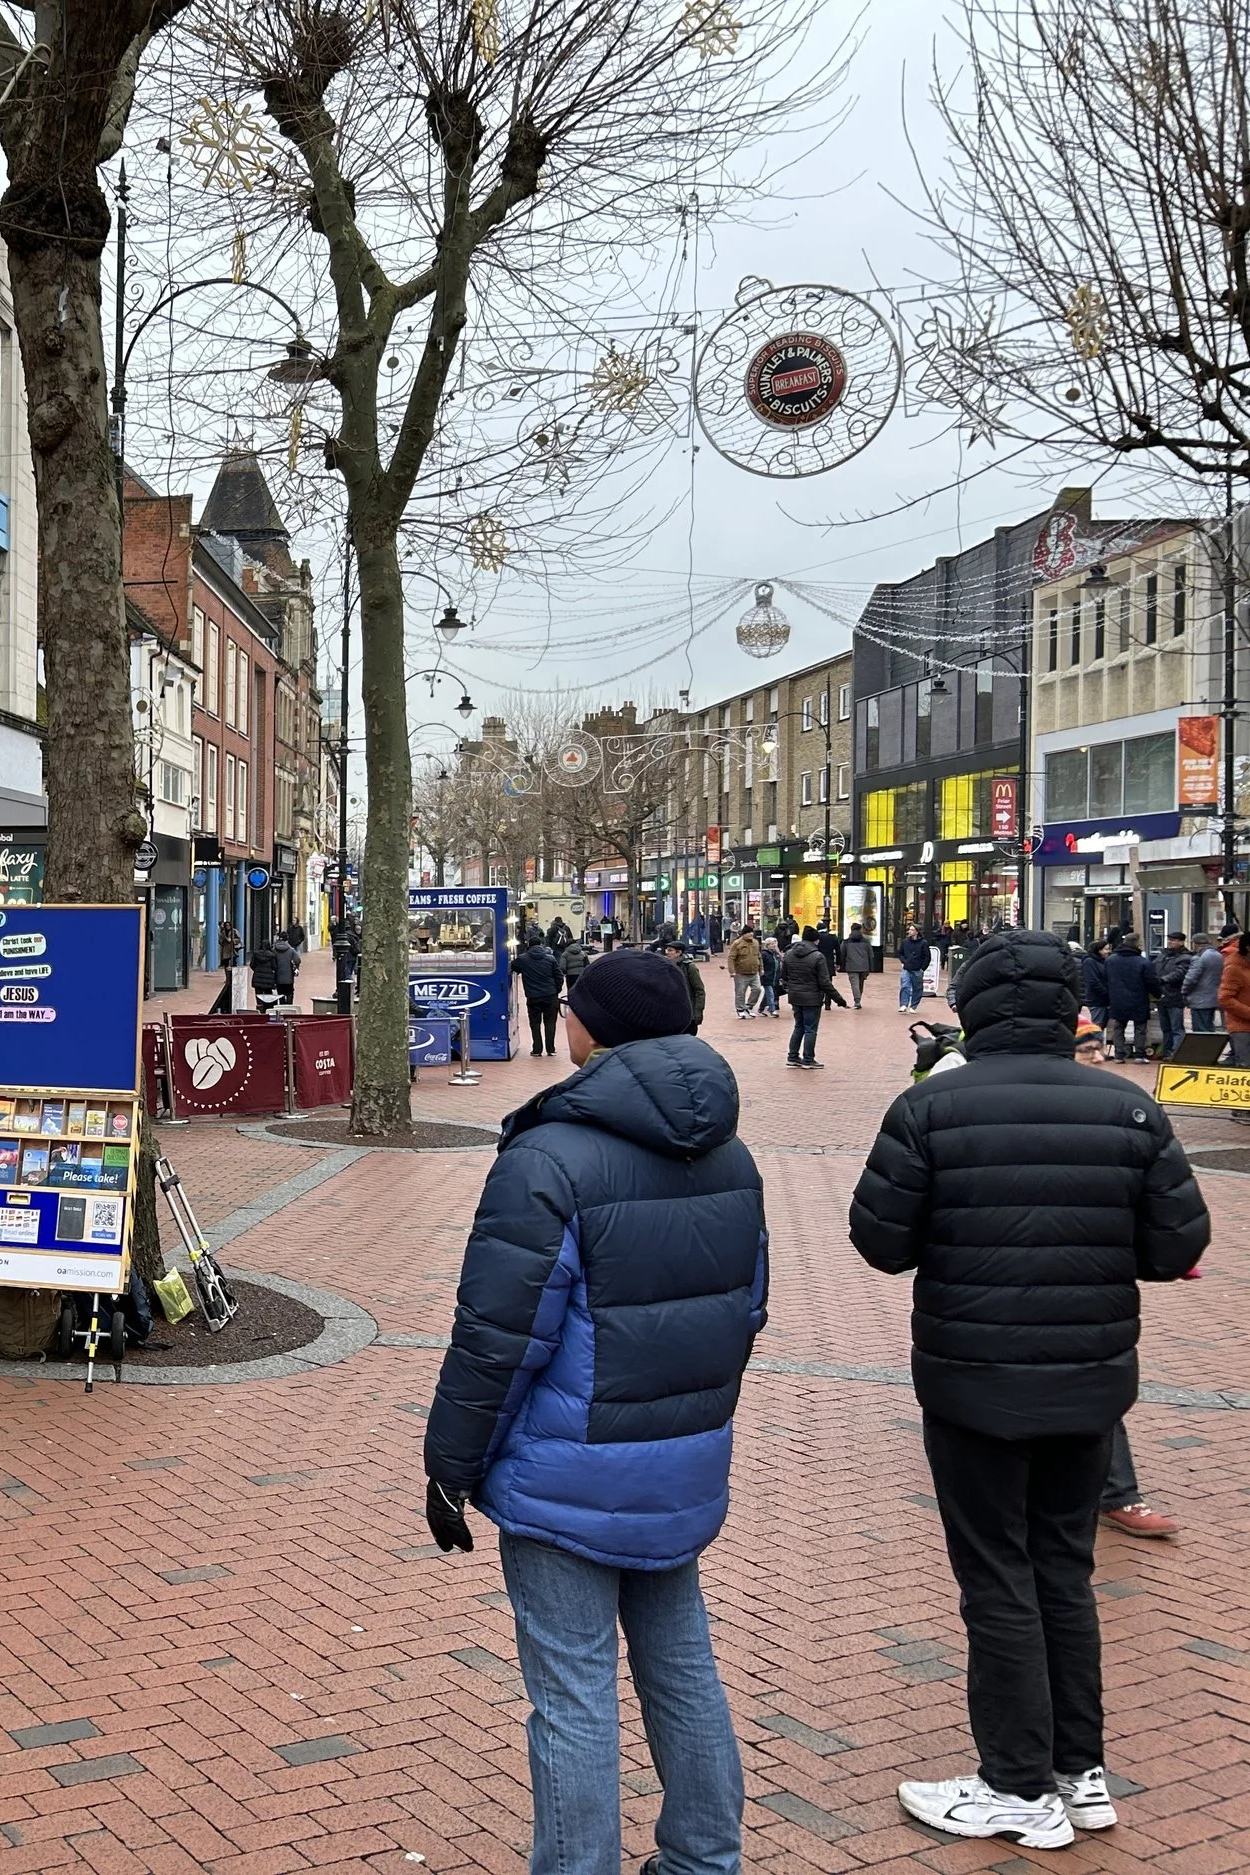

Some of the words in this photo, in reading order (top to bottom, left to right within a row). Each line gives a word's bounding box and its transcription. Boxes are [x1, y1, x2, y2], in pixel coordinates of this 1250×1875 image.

[749, 351, 770, 396] SUPERIOR
[769, 336, 812, 352] READING
[814, 340, 844, 375] BISCUITS
[760, 350, 786, 399] HUNTLEY
[797, 346, 833, 383] PALMERS
[774, 371, 817, 392] BREAKFAST
[770, 388, 827, 415] BISCUITS
[438, 893, 464, 905] FRESH
[465, 893, 497, 905] COFFEE
[2, 987, 35, 1002] JESUS
[414, 984, 469, 1000] MEZZO
[4, 1011, 15, 1019] am
[16, 1009, 27, 1019] the
[315, 1058, 335, 1070] COSTA
[62, 1171, 93, 1182] Please
[94, 1173, 118, 1184] take!
[56, 1266, 114, 1279] oamission.com
